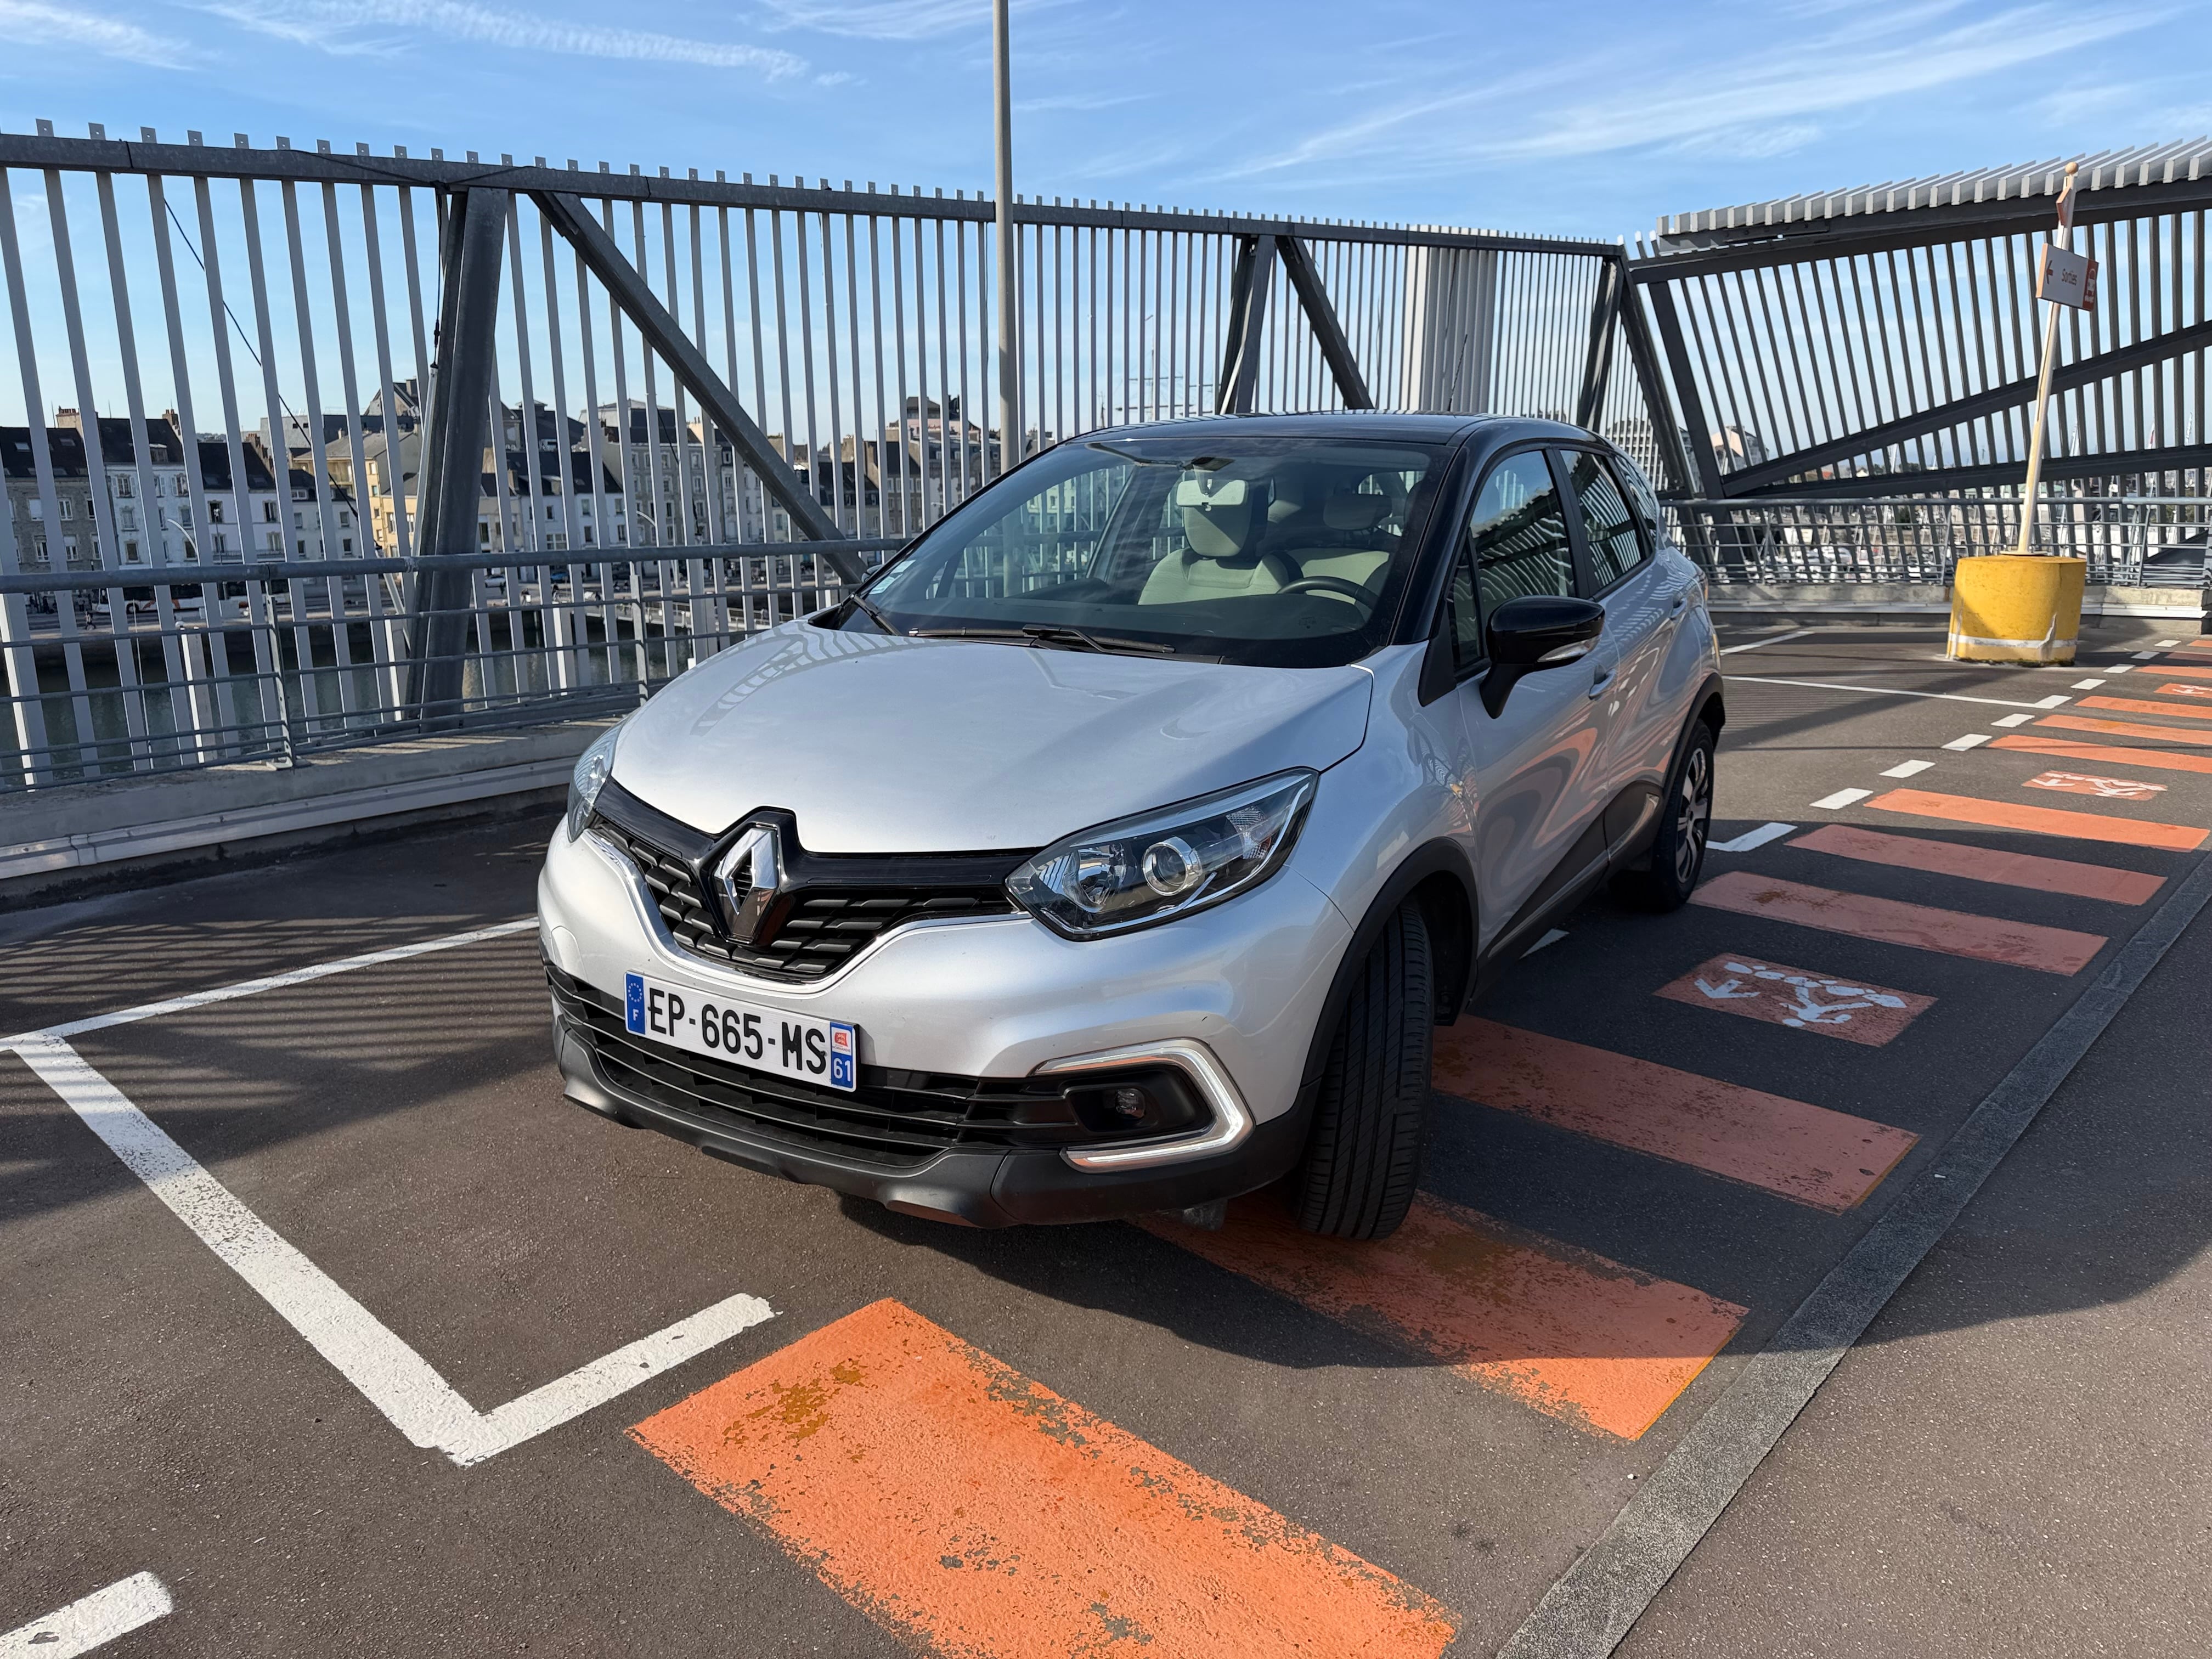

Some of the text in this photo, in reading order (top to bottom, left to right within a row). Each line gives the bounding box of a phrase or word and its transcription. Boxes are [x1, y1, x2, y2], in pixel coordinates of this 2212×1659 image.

[633, 1008, 639, 1022] F
[649, 988, 827, 1075] EP-665-MS
[833, 1057, 851, 1082] 61
